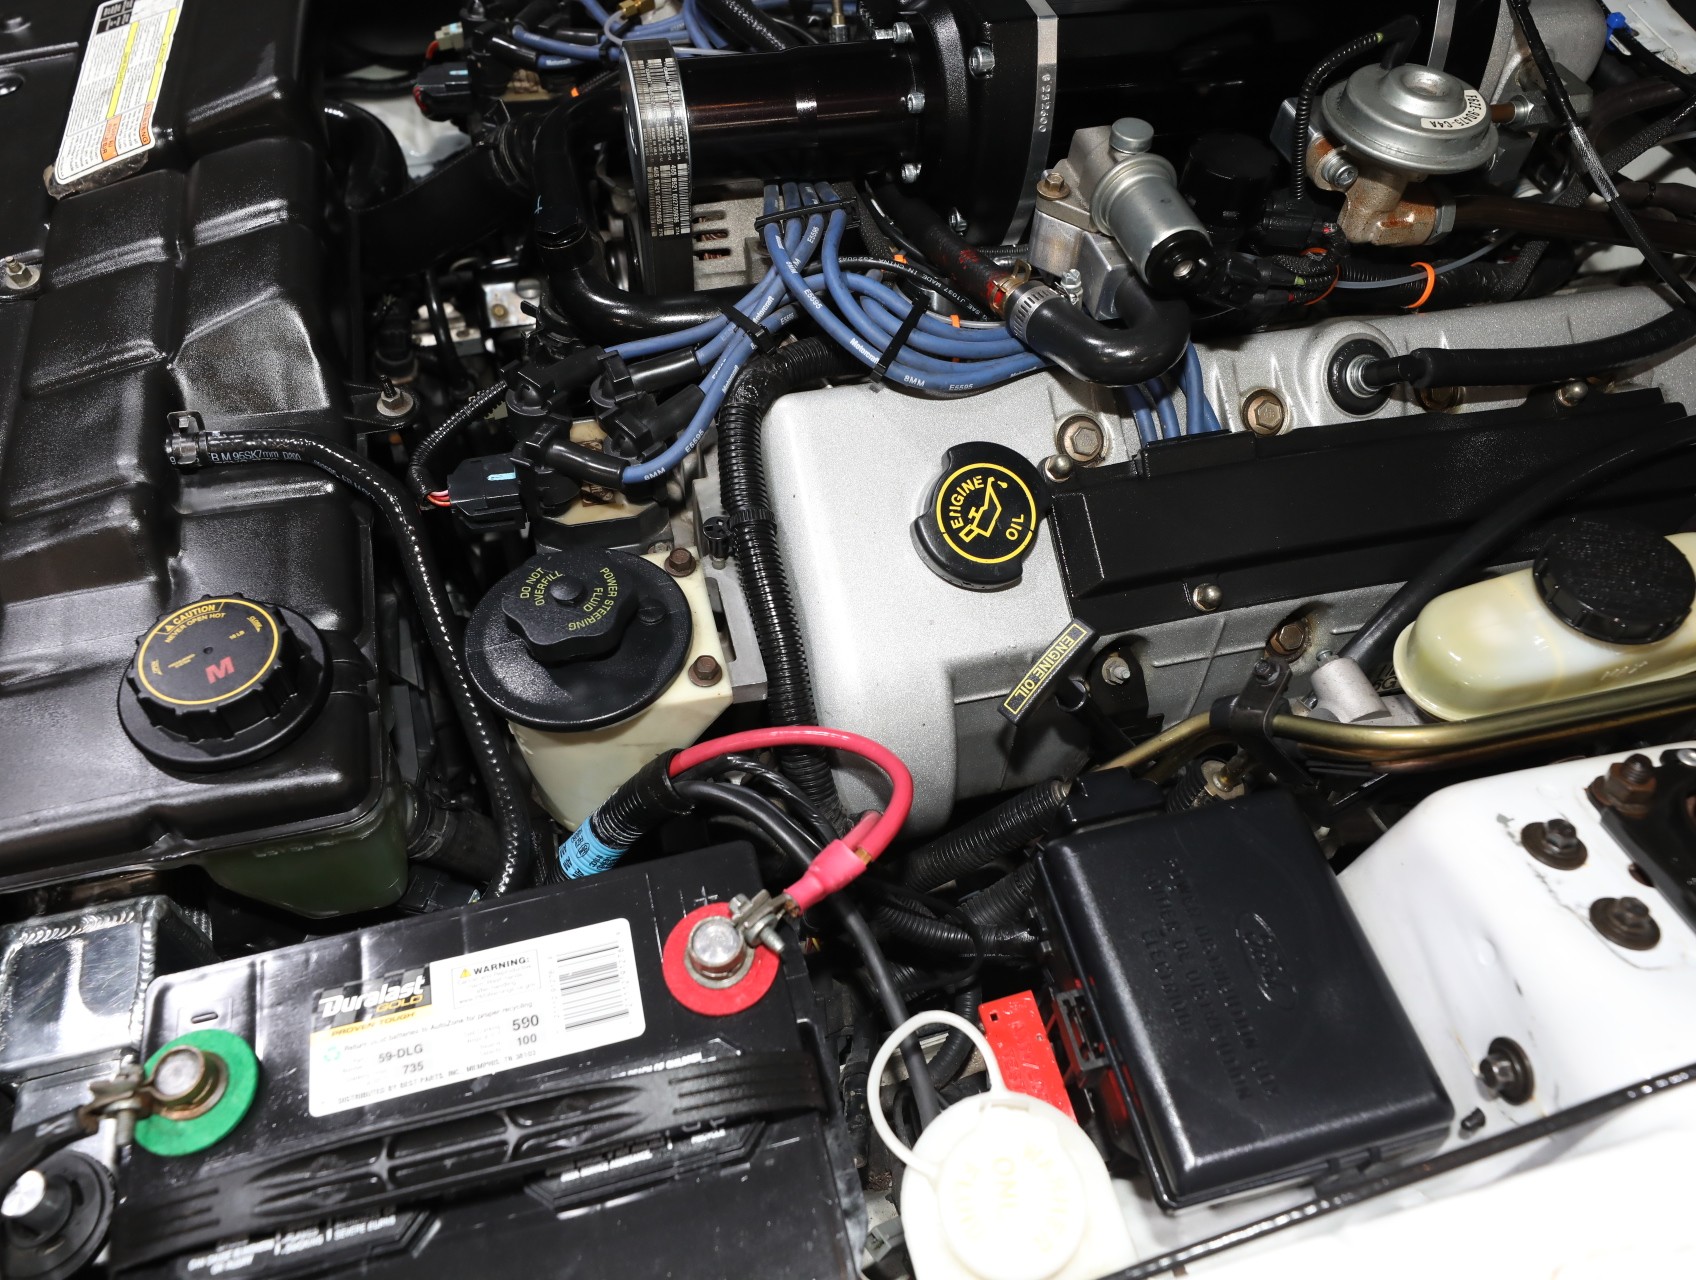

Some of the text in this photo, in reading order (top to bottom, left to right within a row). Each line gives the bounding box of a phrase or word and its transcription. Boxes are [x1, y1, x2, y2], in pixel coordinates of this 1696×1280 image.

[803, 289, 822, 309] E5595
[903, 374, 925, 387] 8MM
[949, 383, 973, 391] E5595
[643, 428, 704, 481] 8MM E5595
[948, 475, 985, 529] ENGINE
[1005, 514, 1024, 541] OIL
[520, 567, 545, 599] DO NOT
[534, 570, 564, 606] OVERFILL
[568, 567, 618, 631] POWER STEERING
[583, 587, 603, 612] FLUID
[164, 625, 187, 643] NEVER
[186, 614, 208, 626] OPEN
[173, 604, 216, 625] CAUTION
[205, 656, 235, 685] M
[1014, 635, 1075, 698] ENGINE OIL
[318, 974, 426, 1019] Duralast
[376, 994, 424, 1013] GOLD
[331, 1012, 415, 1037] PROVEN TOUGH
[512, 1014, 539, 1031] 590
[378, 1043, 423, 1064] 59-DLG
[517, 1033, 537, 1046] 100
[402, 1061, 424, 1075] 735
